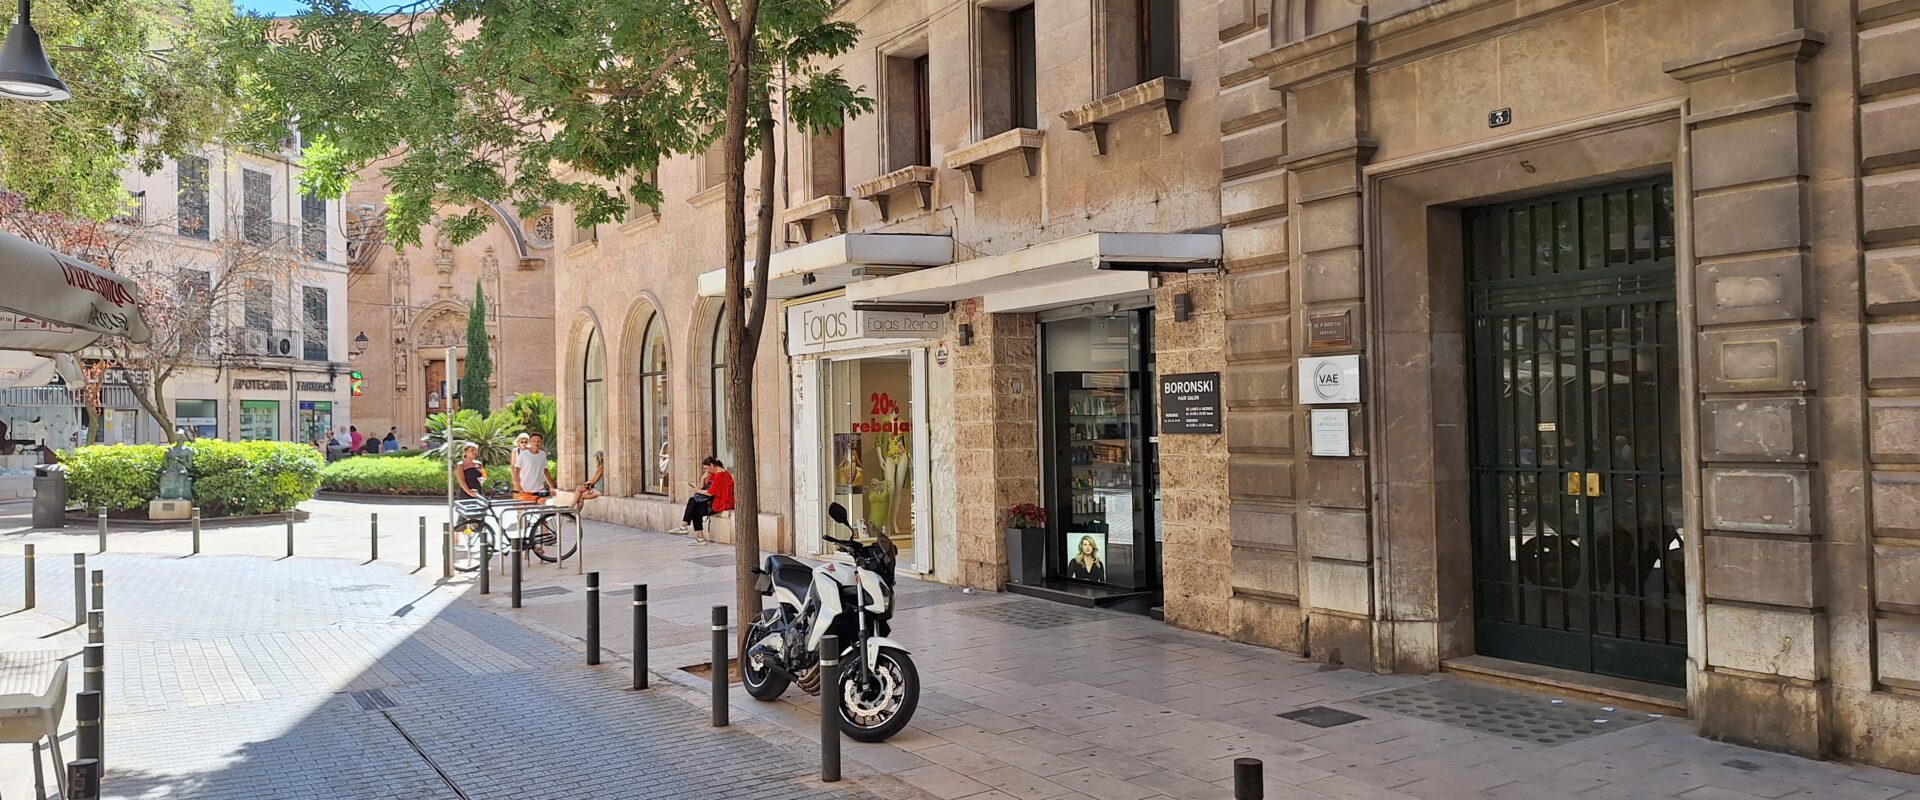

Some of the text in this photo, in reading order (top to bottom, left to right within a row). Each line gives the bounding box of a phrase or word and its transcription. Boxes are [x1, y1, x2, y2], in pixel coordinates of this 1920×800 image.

[1495, 112, 1504, 124] 3
[1519, 160, 1536, 174] 5
[803, 309, 848, 351] Fajas
[867, 317, 899, 334] Fajas
[904, 317, 939, 330] Reina
[1318, 373, 1339, 384] VAE
[1164, 380, 1213, 394] BORONSKI
[870, 392, 899, 414] 20%
[852, 417, 912, 436] rebaja
